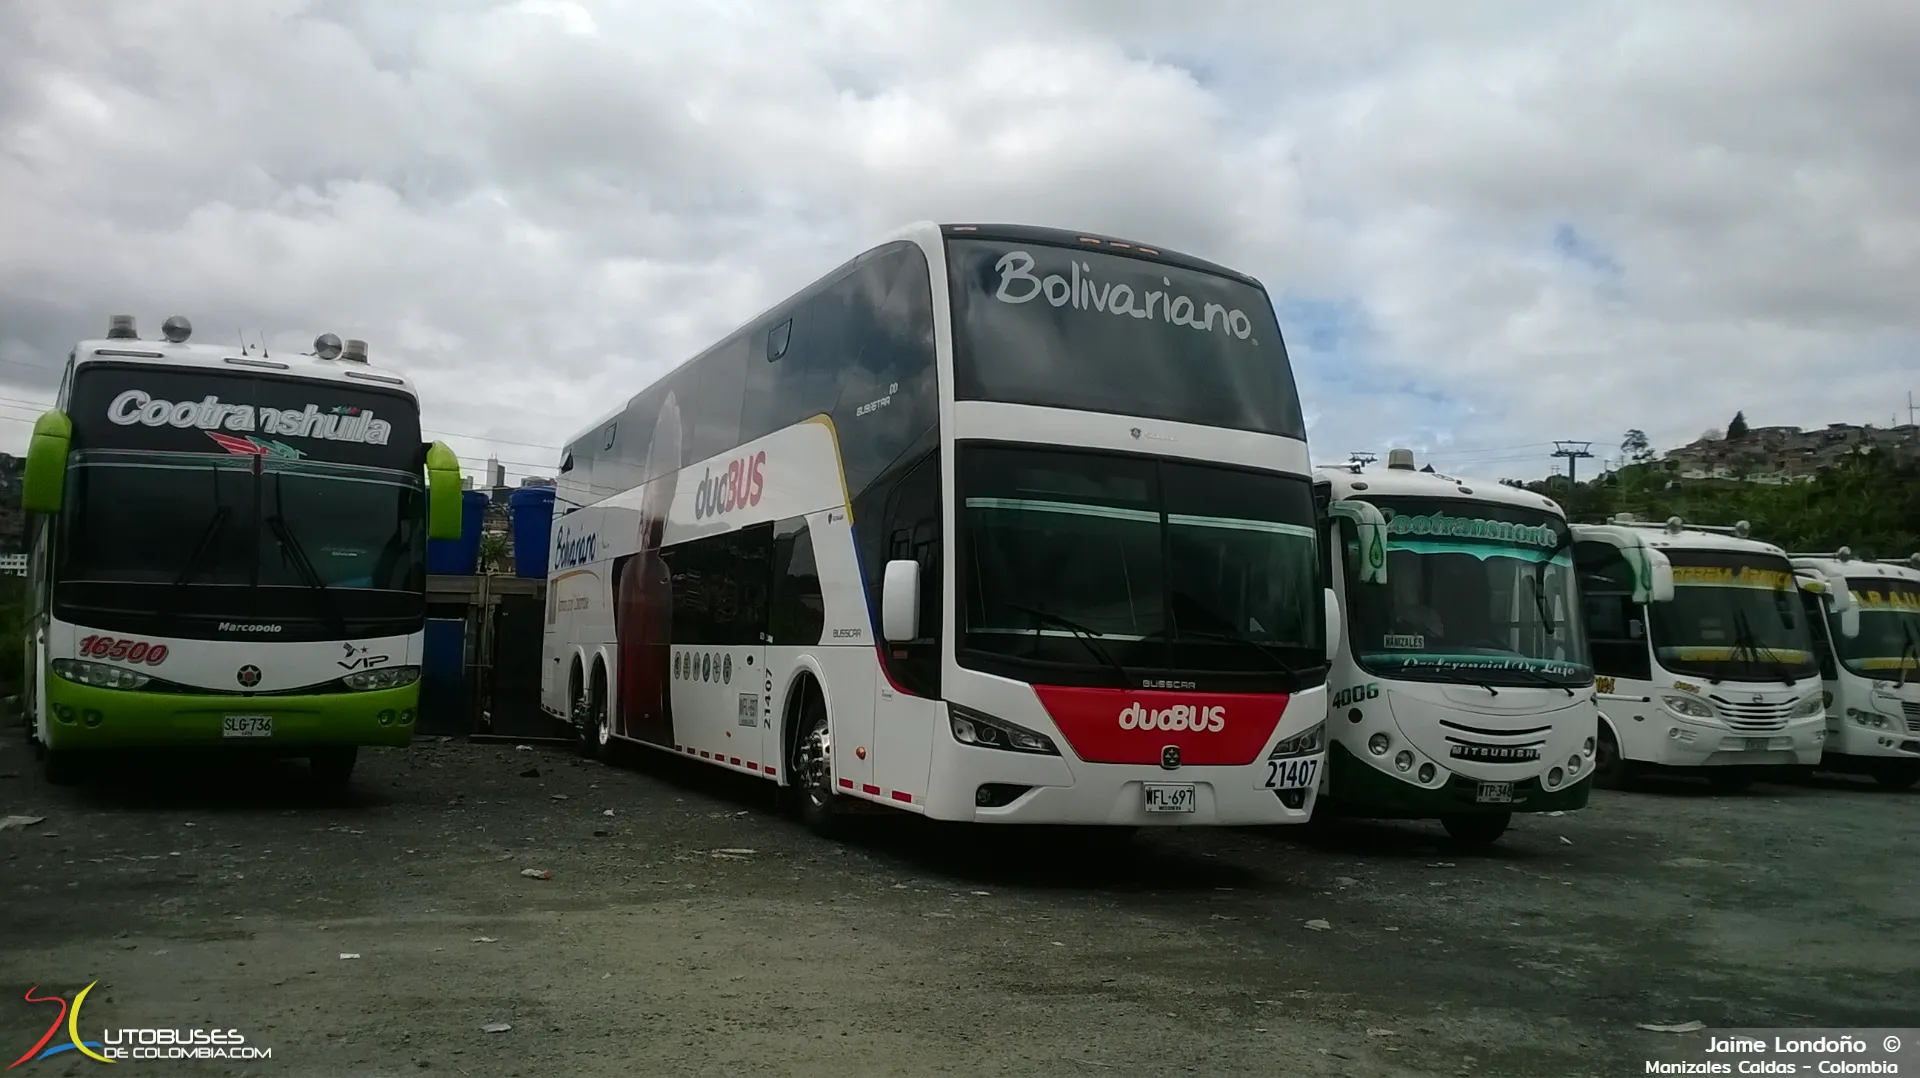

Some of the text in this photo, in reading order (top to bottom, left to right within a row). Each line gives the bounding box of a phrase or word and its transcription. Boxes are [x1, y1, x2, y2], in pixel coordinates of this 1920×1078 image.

[995, 251, 1251, 340] Bolivariano
[107, 389, 392, 446] Cootranshuila
[695, 450, 766, 520] duoBUS
[218, 622, 282, 633] Marcopolo
[833, 628, 861, 638] BUSSCAR
[79, 634, 169, 666] 16500
[1385, 637, 1423, 647] MANIZALES
[337, 655, 389, 670] VIP
[1540, 662, 1575, 678] Lujo
[1142, 679, 1196, 689] BUSSCAR
[1332, 682, 1379, 709] 4006
[763, 667, 773, 730] 21407
[1118, 702, 1226, 731] duoBUS
[1452, 745, 1541, 758] MITSUBISHI
[1264, 760, 1317, 790] 21407
